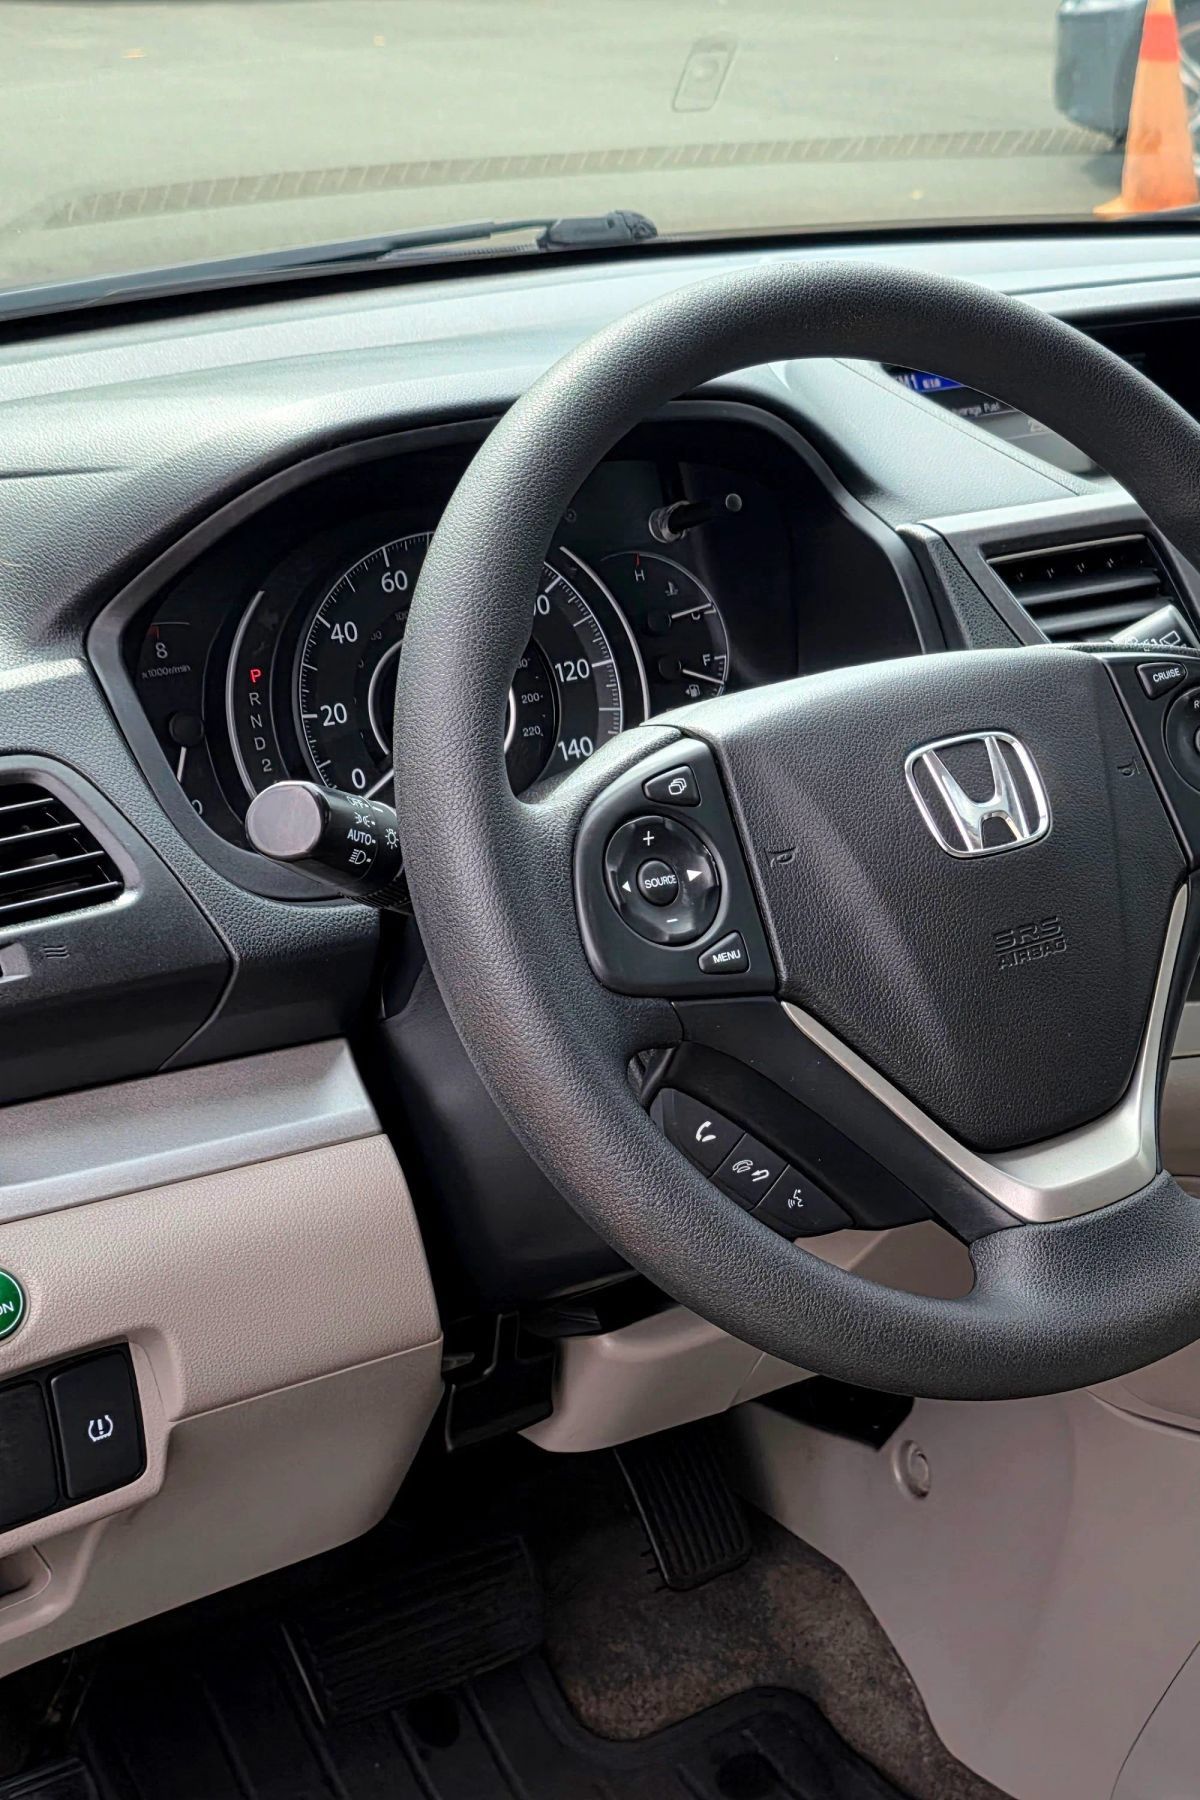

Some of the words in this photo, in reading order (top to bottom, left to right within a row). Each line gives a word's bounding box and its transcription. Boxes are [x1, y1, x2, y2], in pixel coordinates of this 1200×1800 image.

[381, 570, 408, 593] 60
[634, 569, 646, 582] H
[330, 621, 358, 644] 40
[155, 642, 168, 659] 8
[702, 653, 711, 666] F
[250, 668, 262, 683] P
[555, 658, 590, 683] 120
[1152, 667, 1181, 683] CRUISE
[249, 692, 261, 706] R
[521, 692, 540, 704] 200
[250, 714, 263, 729] N
[320, 703, 347, 726] 20
[522, 725, 541, 737] 220
[254, 737, 266, 751] D
[558, 736, 593, 762] 140
[262, 758, 273, 772] 2
[351, 768, 366, 789] 0
[347, 828, 372, 846] AUTO
[644, 874, 677, 889] SOURCE
[993, 915, 1062, 954] SRS
[712, 949, 741, 964] MENU
[999, 938, 1067, 970] AIRBAG
